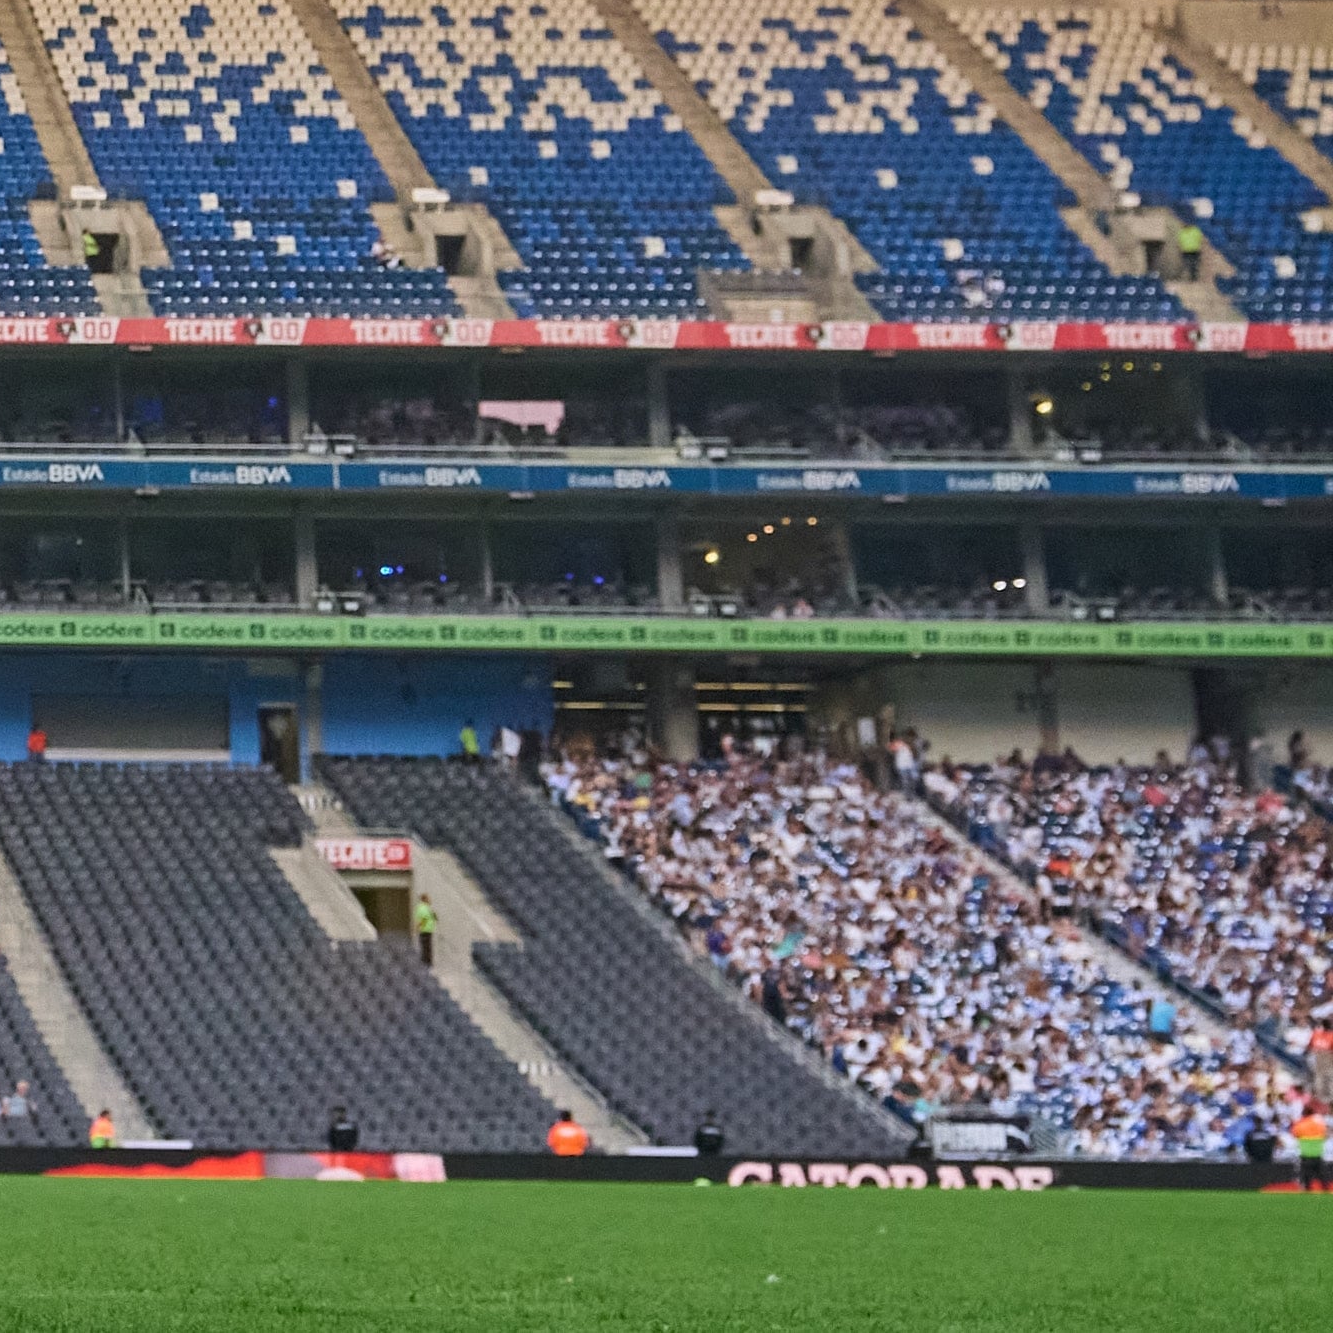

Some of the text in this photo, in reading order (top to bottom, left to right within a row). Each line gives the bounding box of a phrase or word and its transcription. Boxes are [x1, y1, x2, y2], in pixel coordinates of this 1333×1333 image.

[163, 320, 237, 341] TECATE
[349, 321, 424, 342] TECATE
[534, 322, 610, 343] TECATE
[49, 464, 104, 482] BBVA
[236, 466, 291, 484] BBVA
[426, 467, 482, 485] BBVA
[615, 469, 671, 487] BBVA
[804, 471, 860, 489] BBVA
[994, 473, 1050, 491] BBVA
[314, 839, 387, 862] TECATE
[728, 1162, 1054, 1190] GATORADE
